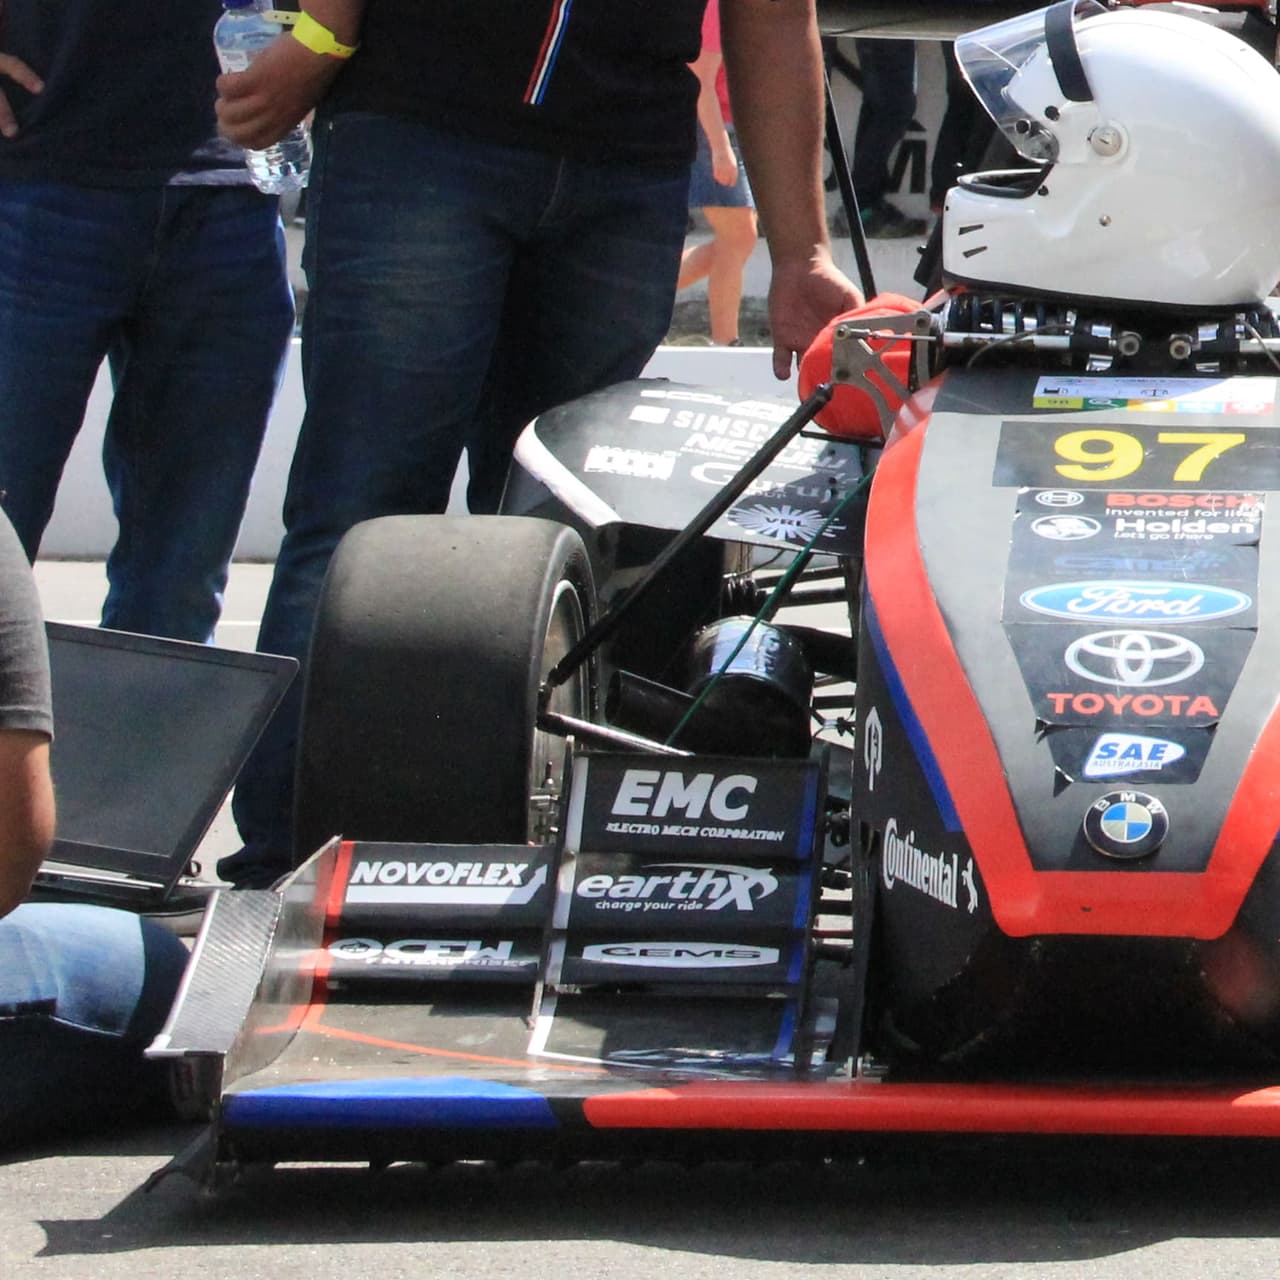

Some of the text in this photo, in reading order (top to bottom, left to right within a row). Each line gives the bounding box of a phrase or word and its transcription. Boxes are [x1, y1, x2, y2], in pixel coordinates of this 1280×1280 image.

[1053, 429, 1246, 482] 97
[1105, 493, 1257, 508] BOSCH
[1105, 507, 1191, 517] Invented
[1193, 507, 1219, 518] for
[1115, 518, 1255, 535] Holden
[1149, 532, 1170, 542] go
[1174, 531, 1215, 541] there
[1066, 585, 1205, 616] Ford
[1046, 692, 1219, 717] TOYOTA
[1095, 742, 1169, 761] SAE
[610, 769, 758, 822] EMC
[605, 822, 660, 836] ELECTRO
[700, 826, 785, 841] CORPORATION
[882, 817, 958, 909] Continental
[350, 860, 529, 886] NOVOFLEX
[595, 900, 704, 912] charge your ride
